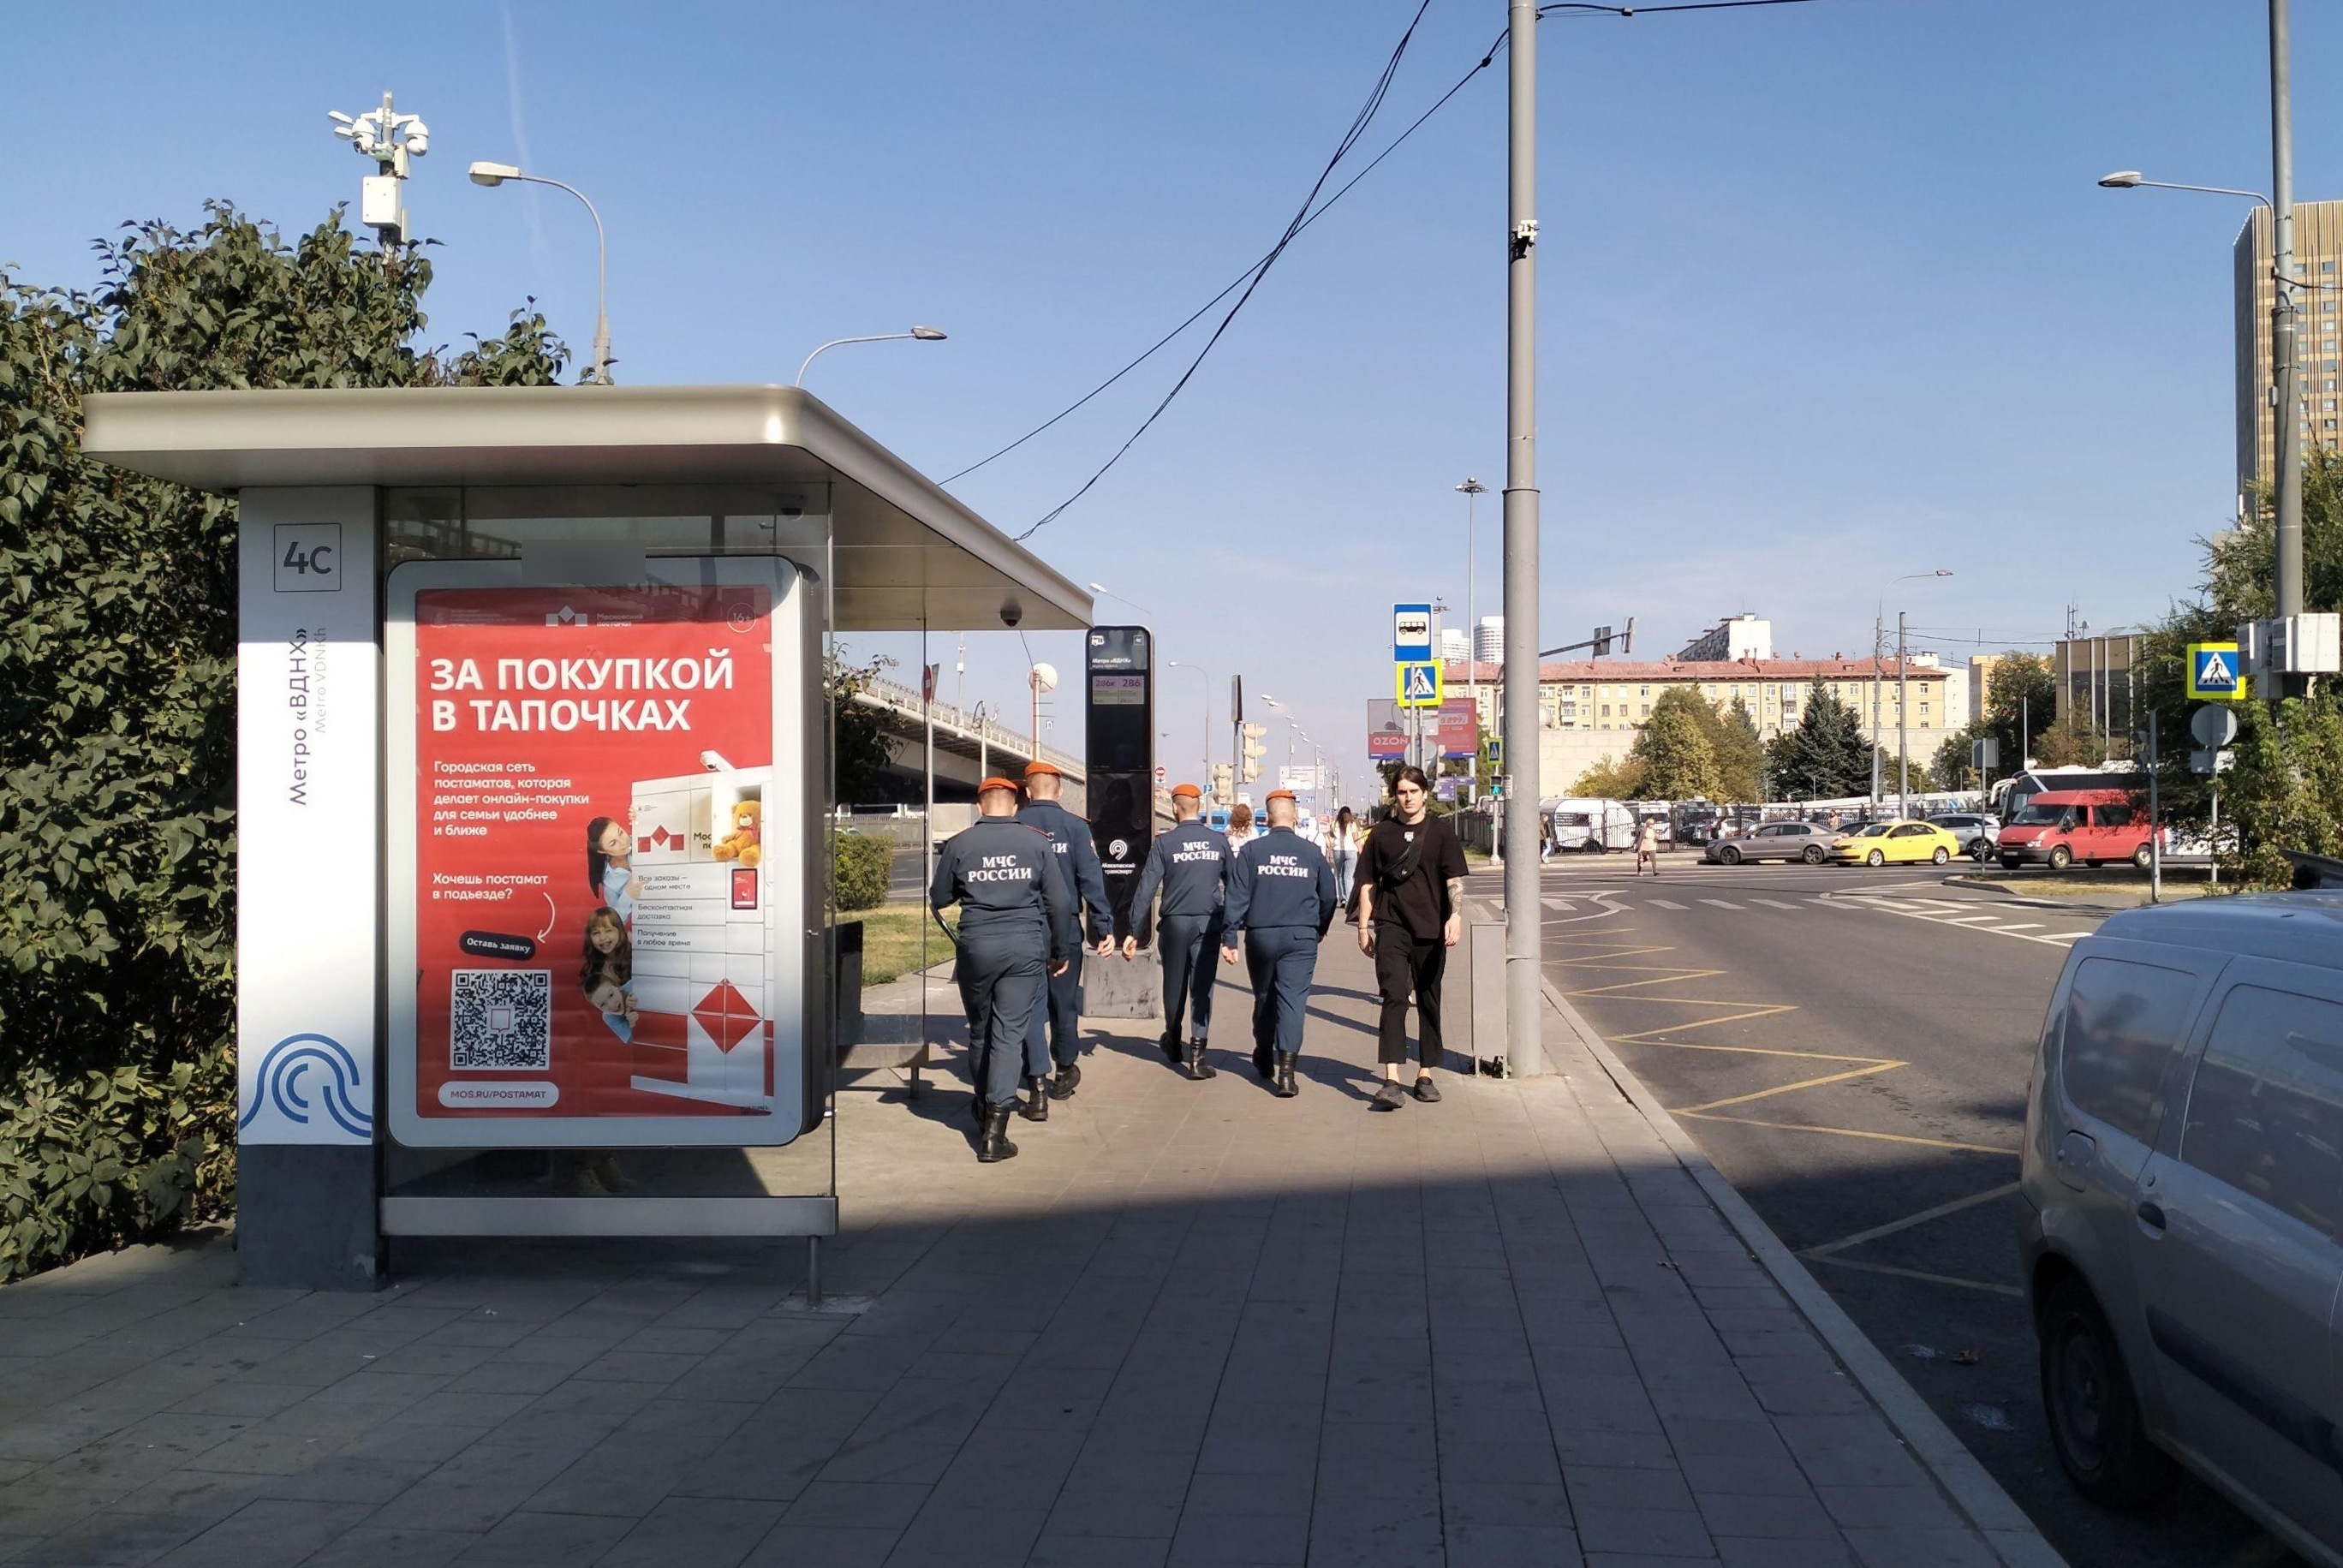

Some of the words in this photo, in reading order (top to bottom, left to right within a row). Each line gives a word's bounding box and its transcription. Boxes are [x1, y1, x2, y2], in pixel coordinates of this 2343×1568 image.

[314, 627, 326, 683] VDNKh
[289, 628, 310, 721] «ВДНХ»
[430, 658, 484, 691] ЗА
[498, 647, 734, 691] ПОКУПКОЙ
[1123, 678, 1141, 687] 286
[314, 688, 326, 733] Metro
[432, 700, 456, 731] В
[468, 699, 691, 732] ТАПОЧКАХ
[1373, 736, 1409, 746] OZON
[289, 728, 310, 805] Метро
[434, 760, 504, 774] Городская
[506, 763, 536, 772] сеть
[434, 779, 515, 789] постаматов,
[517, 778, 571, 790] которая
[433, 795, 479, 805] делает
[482, 792, 590, 806] онлайн-покупки
[433, 811, 456, 821] для
[460, 810, 500, 820] семьи
[503, 808, 558, 822] удобнее
[434, 826, 442, 836] и
[445, 824, 487, 836] ближе
[1183, 840, 1211, 852] МЧС
[982, 855, 1017, 869] МЧС
[1172, 850, 1220, 864] РОССИИ
[1269, 854, 1298, 867] МЧС
[432, 873, 482, 885] Хочешь
[486, 875, 549, 885] постамат
[967, 867, 1033, 883] РОССИИ
[1257, 865, 1309, 879] РОССИИ
[432, 891, 440, 899] в
[444, 888, 514, 901] подъезде?
[637, 929, 677, 938] Получение
[466, 937, 498, 950] Оставь
[499, 942, 532, 954] заявку
[450, 1090, 547, 1100] MOS.RU/POSTAMAT
